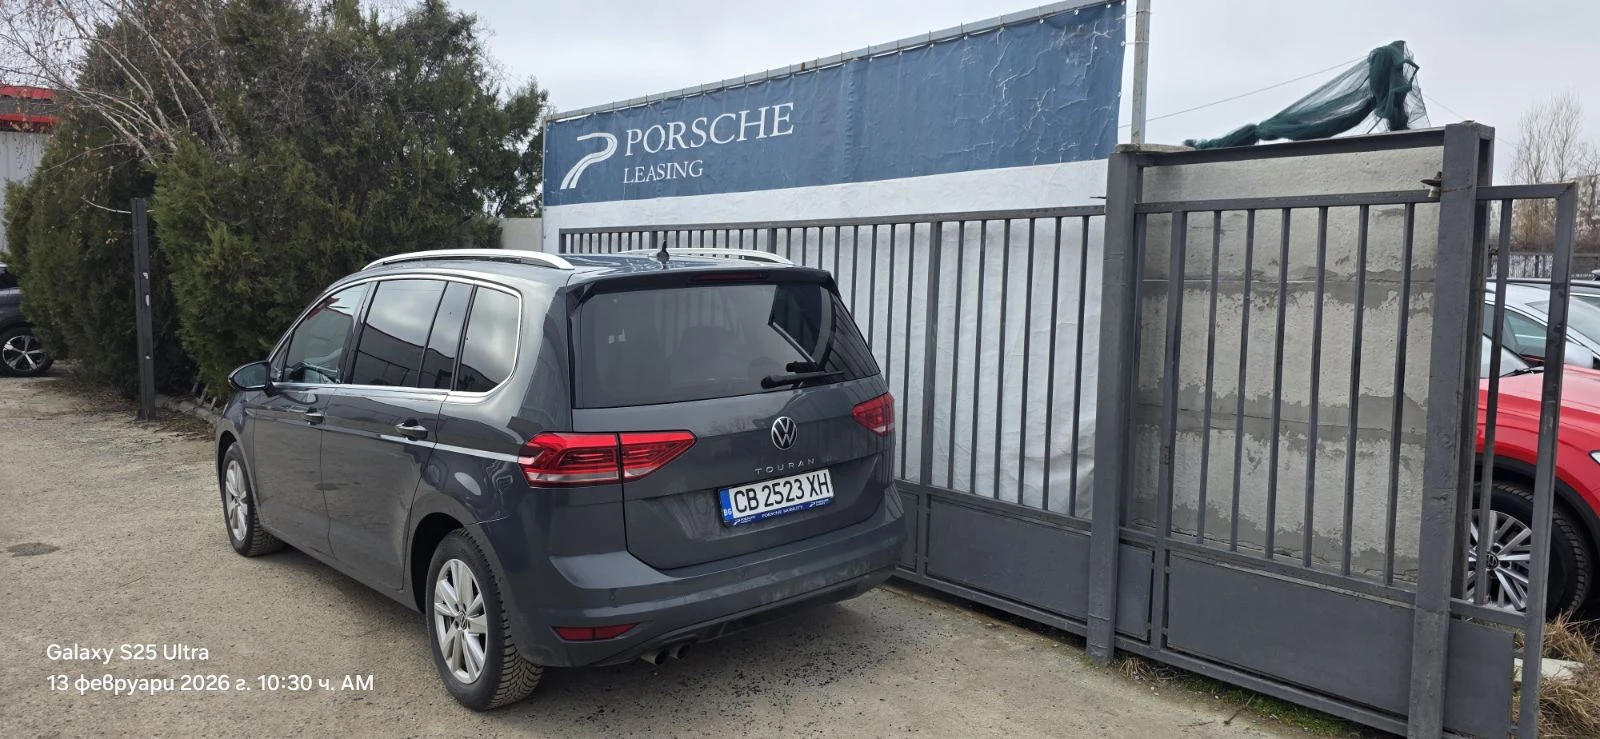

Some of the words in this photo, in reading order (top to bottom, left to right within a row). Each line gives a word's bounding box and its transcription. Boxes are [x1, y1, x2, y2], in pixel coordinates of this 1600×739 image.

[624, 102, 795, 157] PORSCHE
[623, 159, 704, 184] LEASING
[754, 458, 815, 475] TOURAN
[733, 488, 759, 513] CB
[761, 479, 805, 507] 2523
[806, 472, 830, 497] XH
[723, 508, 732, 516] BG
